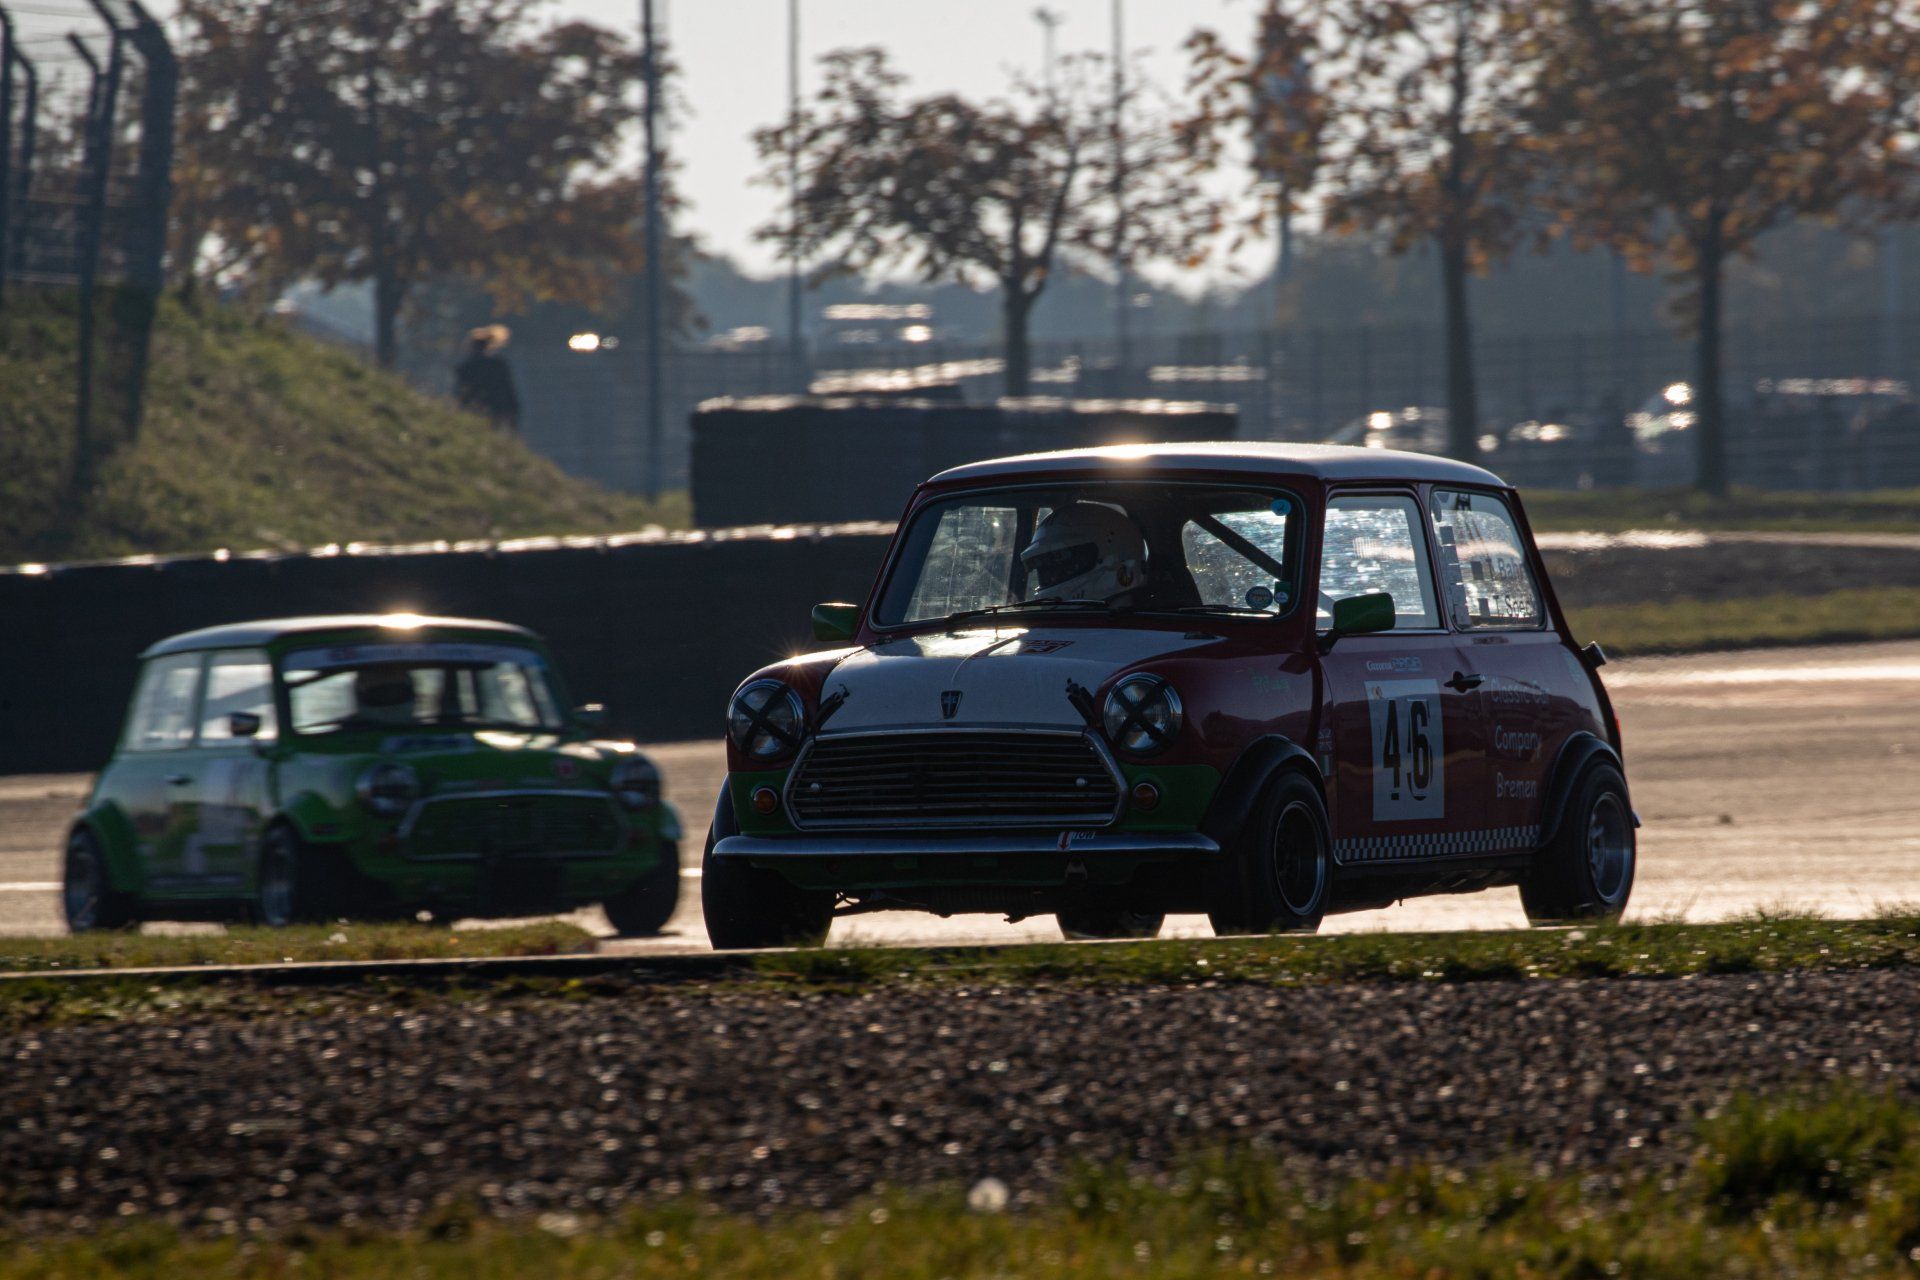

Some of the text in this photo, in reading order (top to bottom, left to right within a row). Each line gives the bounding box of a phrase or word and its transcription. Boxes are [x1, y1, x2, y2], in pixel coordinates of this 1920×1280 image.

[1383, 700, 1430, 791] 46
[1495, 724, 1542, 758] Company
[1496, 771, 1537, 799] Bremen
